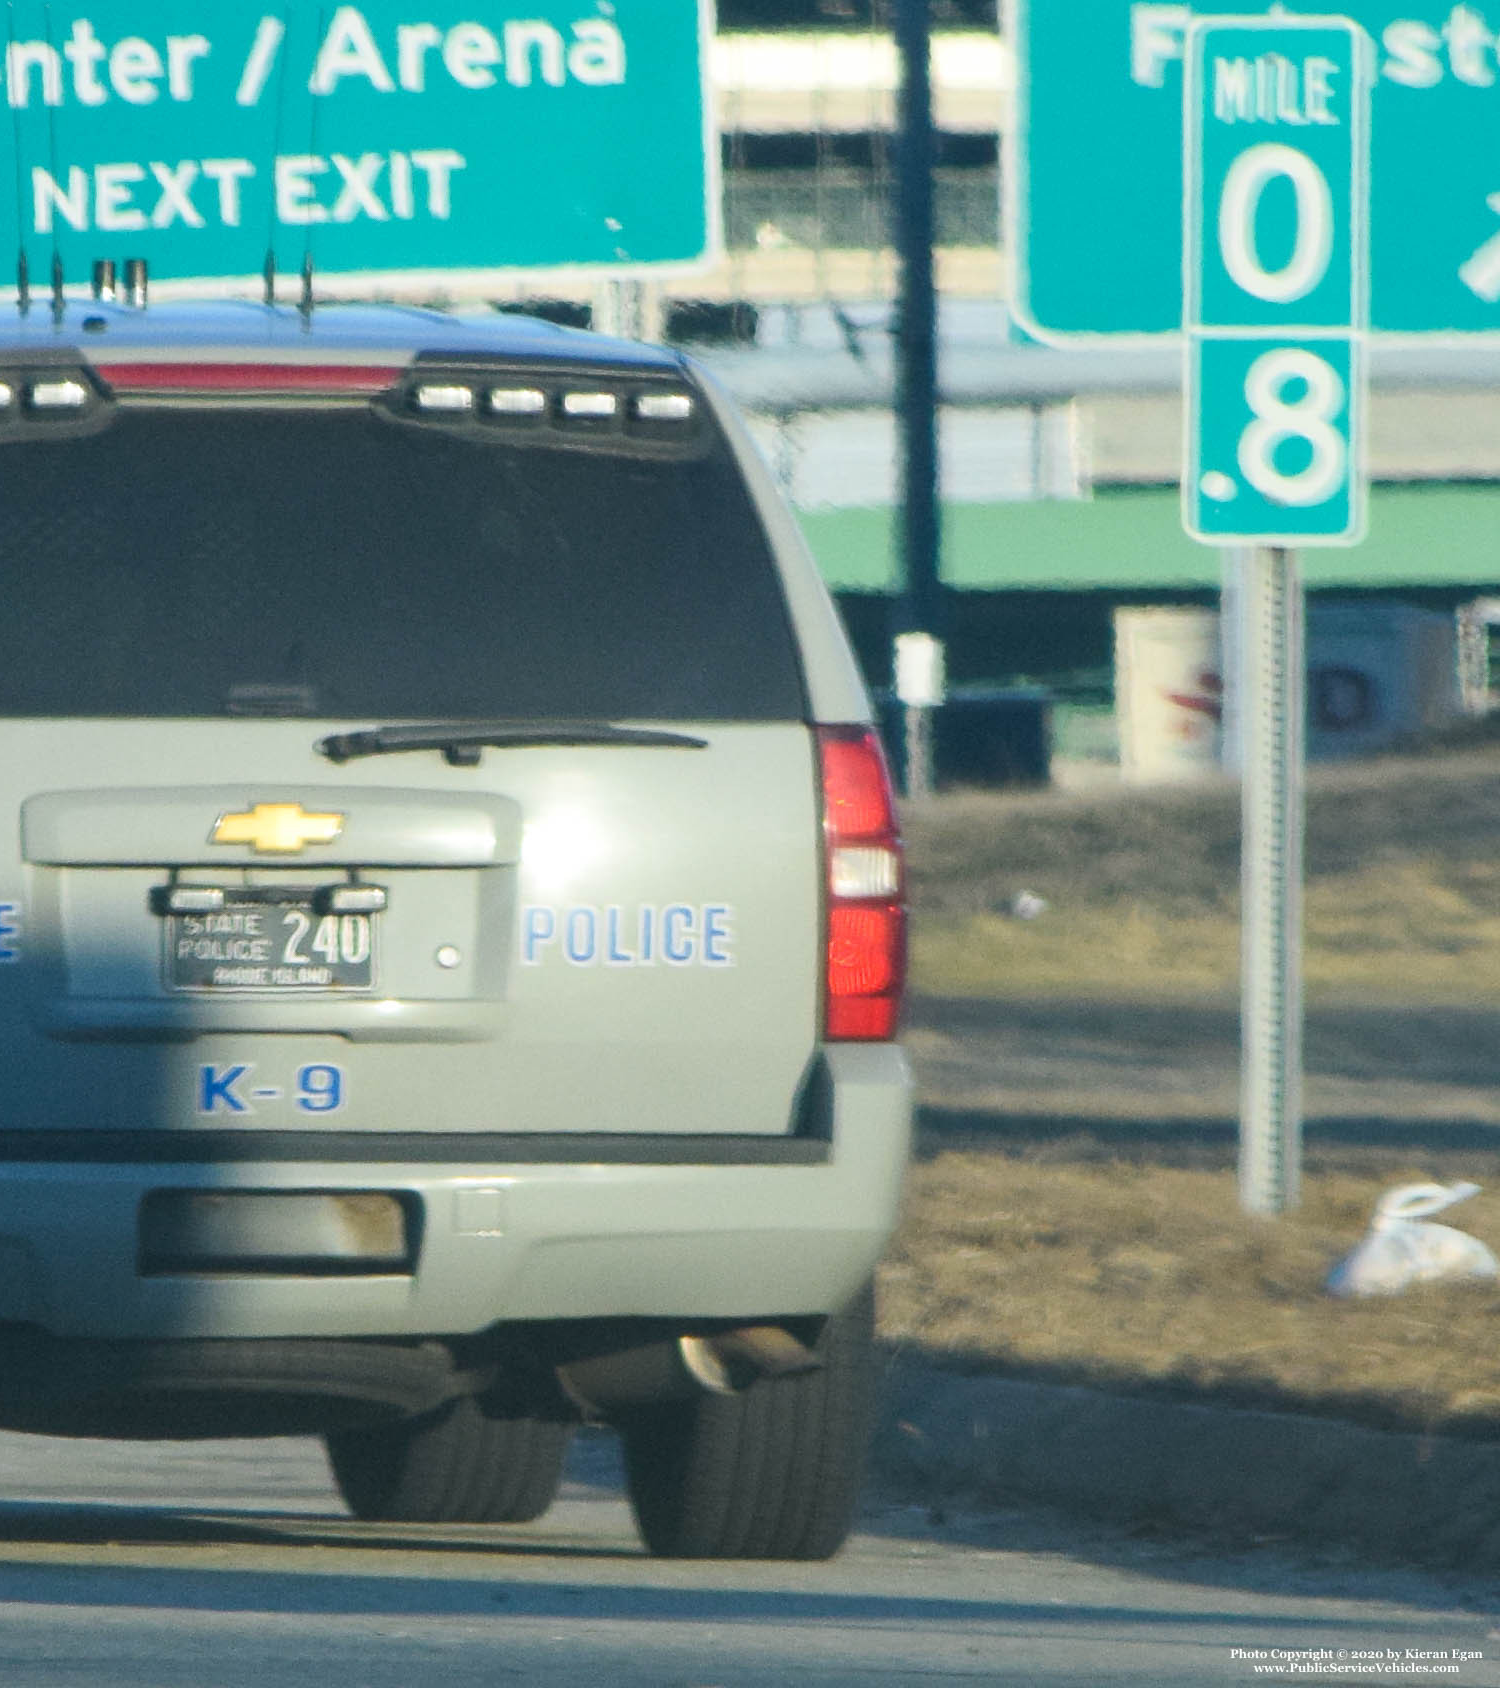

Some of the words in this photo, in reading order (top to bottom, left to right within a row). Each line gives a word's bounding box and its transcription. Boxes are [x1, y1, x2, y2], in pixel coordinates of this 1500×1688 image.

[237, 17, 286, 106] /
[309, 7, 626, 95] Arena
[1214, 54, 1341, 125] MILE
[31, 158, 255, 233] NEXT
[274, 150, 466, 225] EXIT
[1218, 142, 1334, 303] 0
[1201, 348, 1346, 507] .8
[177, 938, 273, 961] POLICE
[183, 913, 265, 936] STATE
[282, 910, 371, 964] 240
[522, 904, 733, 965] POLICE
[199, 1063, 345, 1114] K-9
